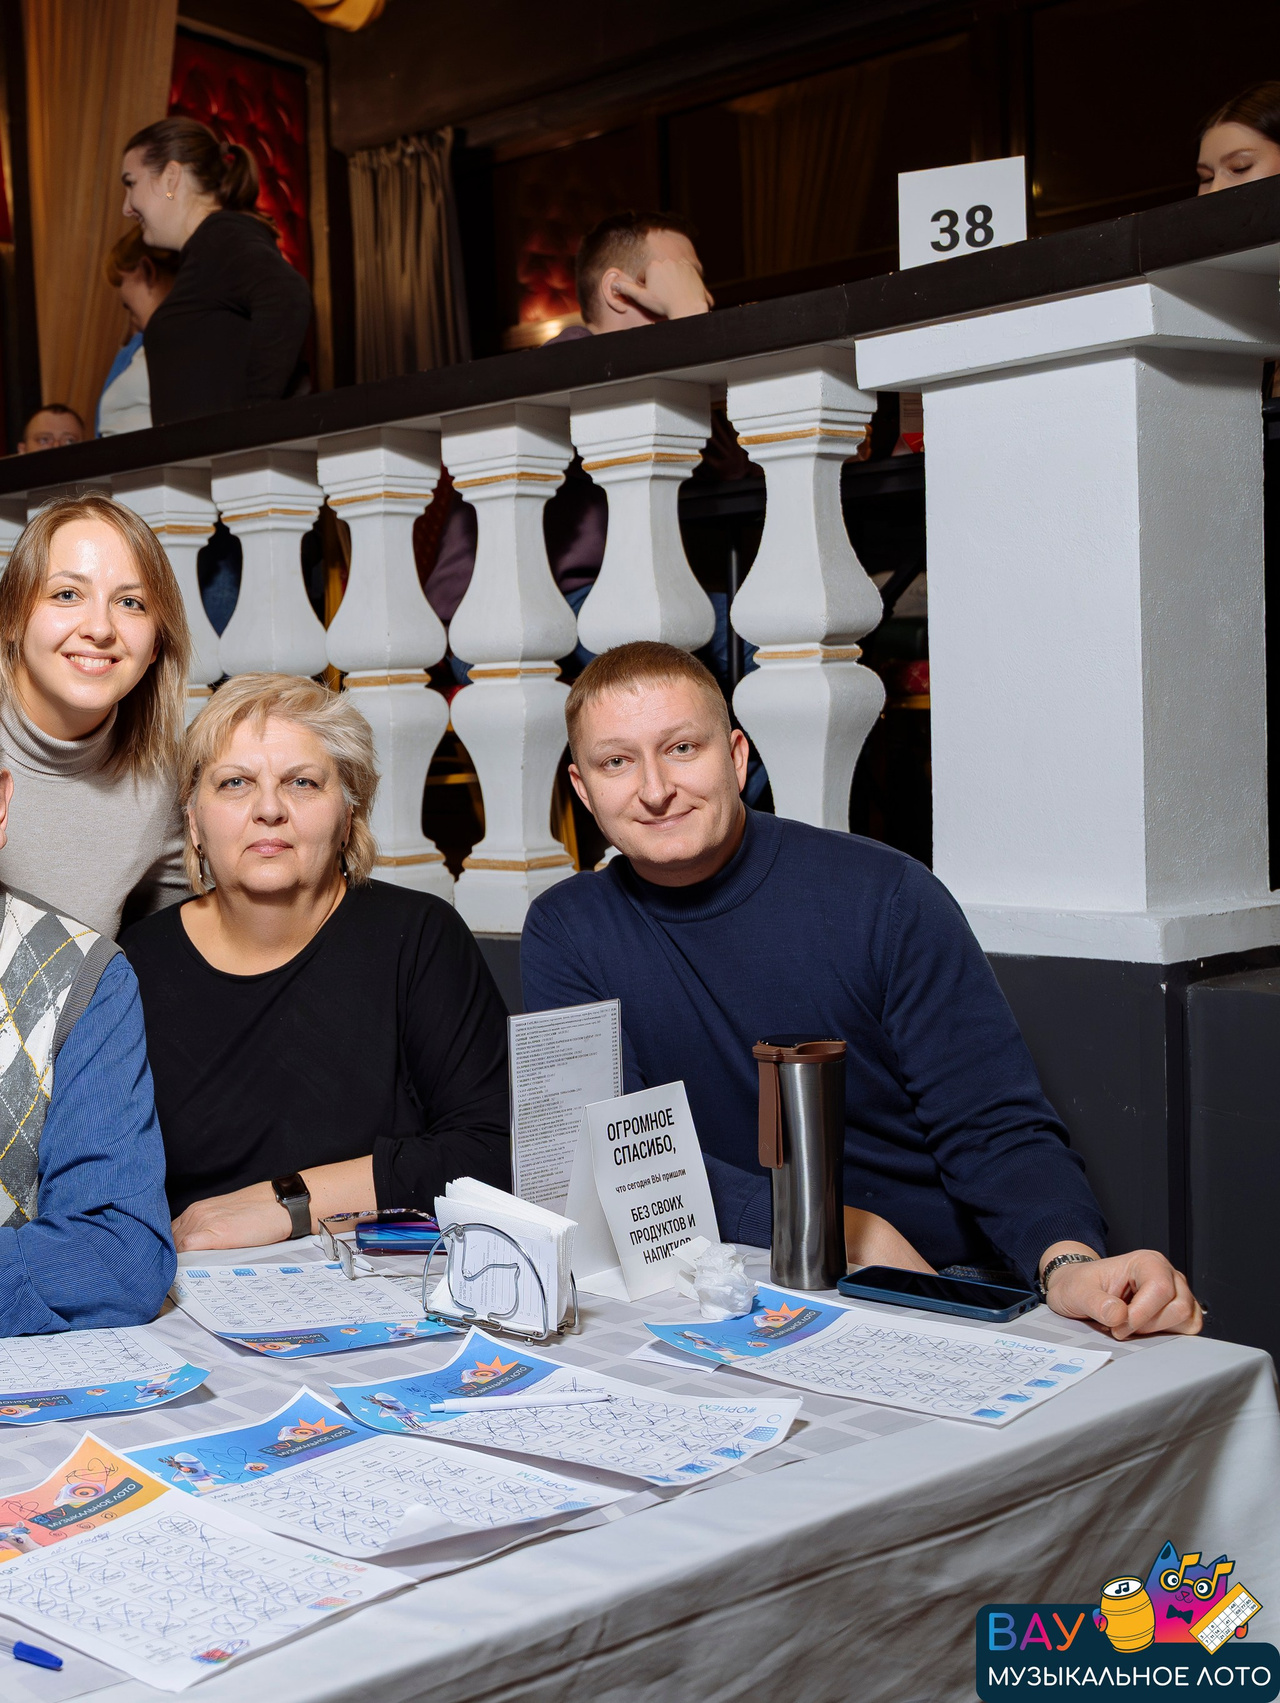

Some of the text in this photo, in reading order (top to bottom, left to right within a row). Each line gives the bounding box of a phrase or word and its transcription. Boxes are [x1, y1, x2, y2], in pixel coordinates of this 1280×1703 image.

[930, 204, 994, 252] 38
[607, 1107, 675, 1142] ОГРОМНОЕ
[613, 1134, 677, 1166] СПАСИБО,
[615, 1168, 687, 1194] что сегодня ВЫ пришли
[630, 1194, 684, 1222] БЕЗ СВОИХ
[629, 1213, 697, 1246] ПРОДУКТОВ И
[47, 1482, 136, 1529] МУЗЫКАЛЬНОЕ ЛОТО
